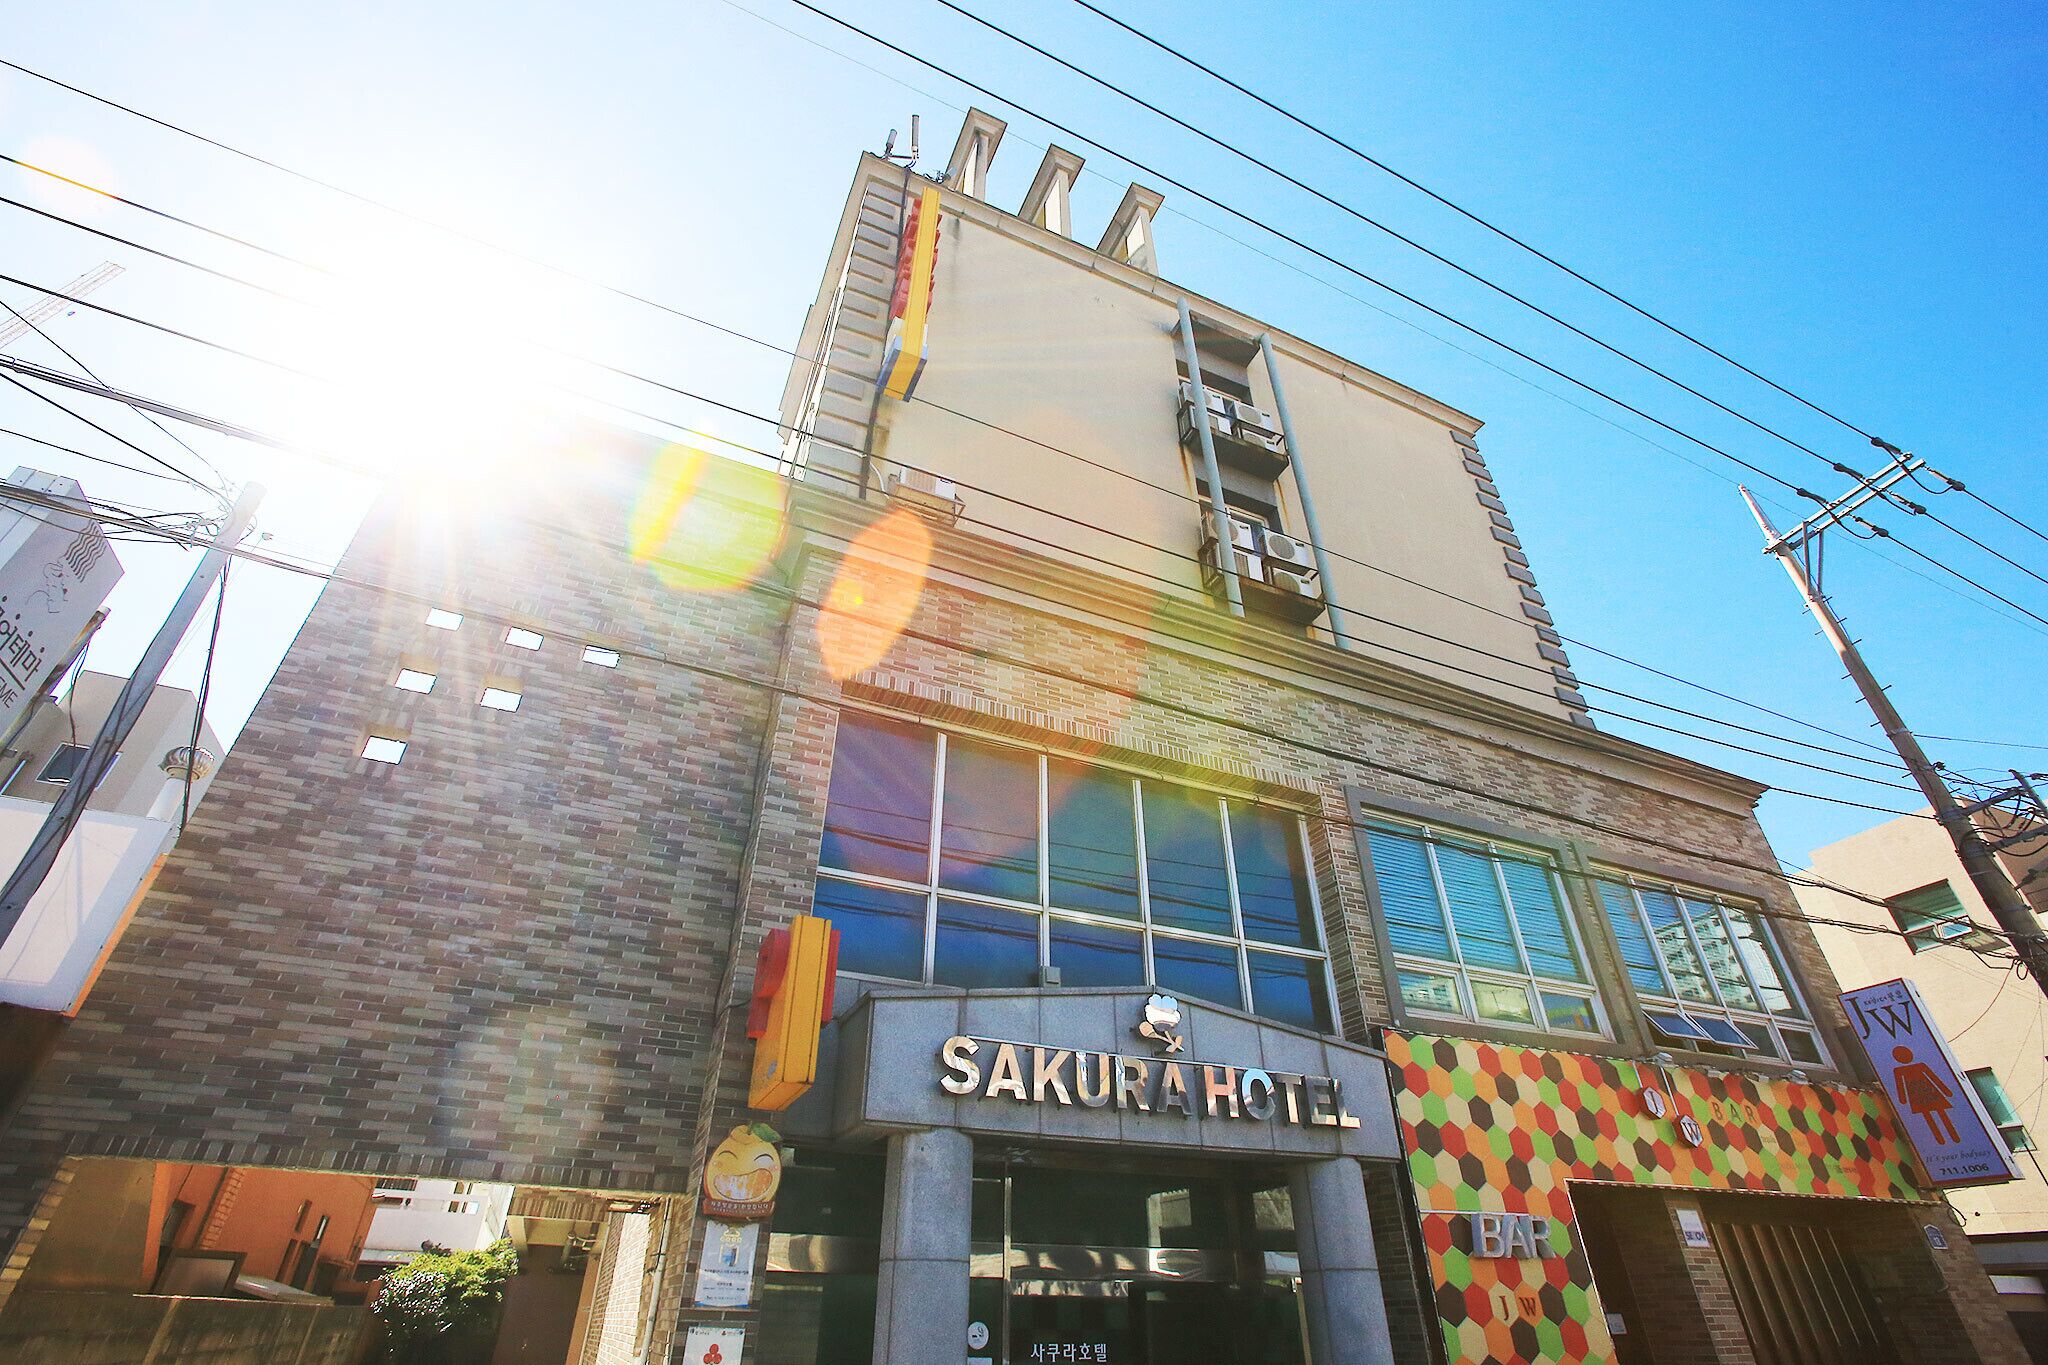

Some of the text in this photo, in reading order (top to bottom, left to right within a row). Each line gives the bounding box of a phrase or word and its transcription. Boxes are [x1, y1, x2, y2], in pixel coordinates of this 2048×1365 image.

[0, 606, 42, 682] 어테마
[1845, 997, 1913, 1039] JW
[940, 1034, 1361, 1130] SAKURA HOTEL
[1711, 1101, 1757, 1126] BAR
[1939, 1163, 1989, 1176] 711.1006
[1471, 1213, 1556, 1259] BAR
[1030, 1342, 1108, 1363] 사쿠라호텔
